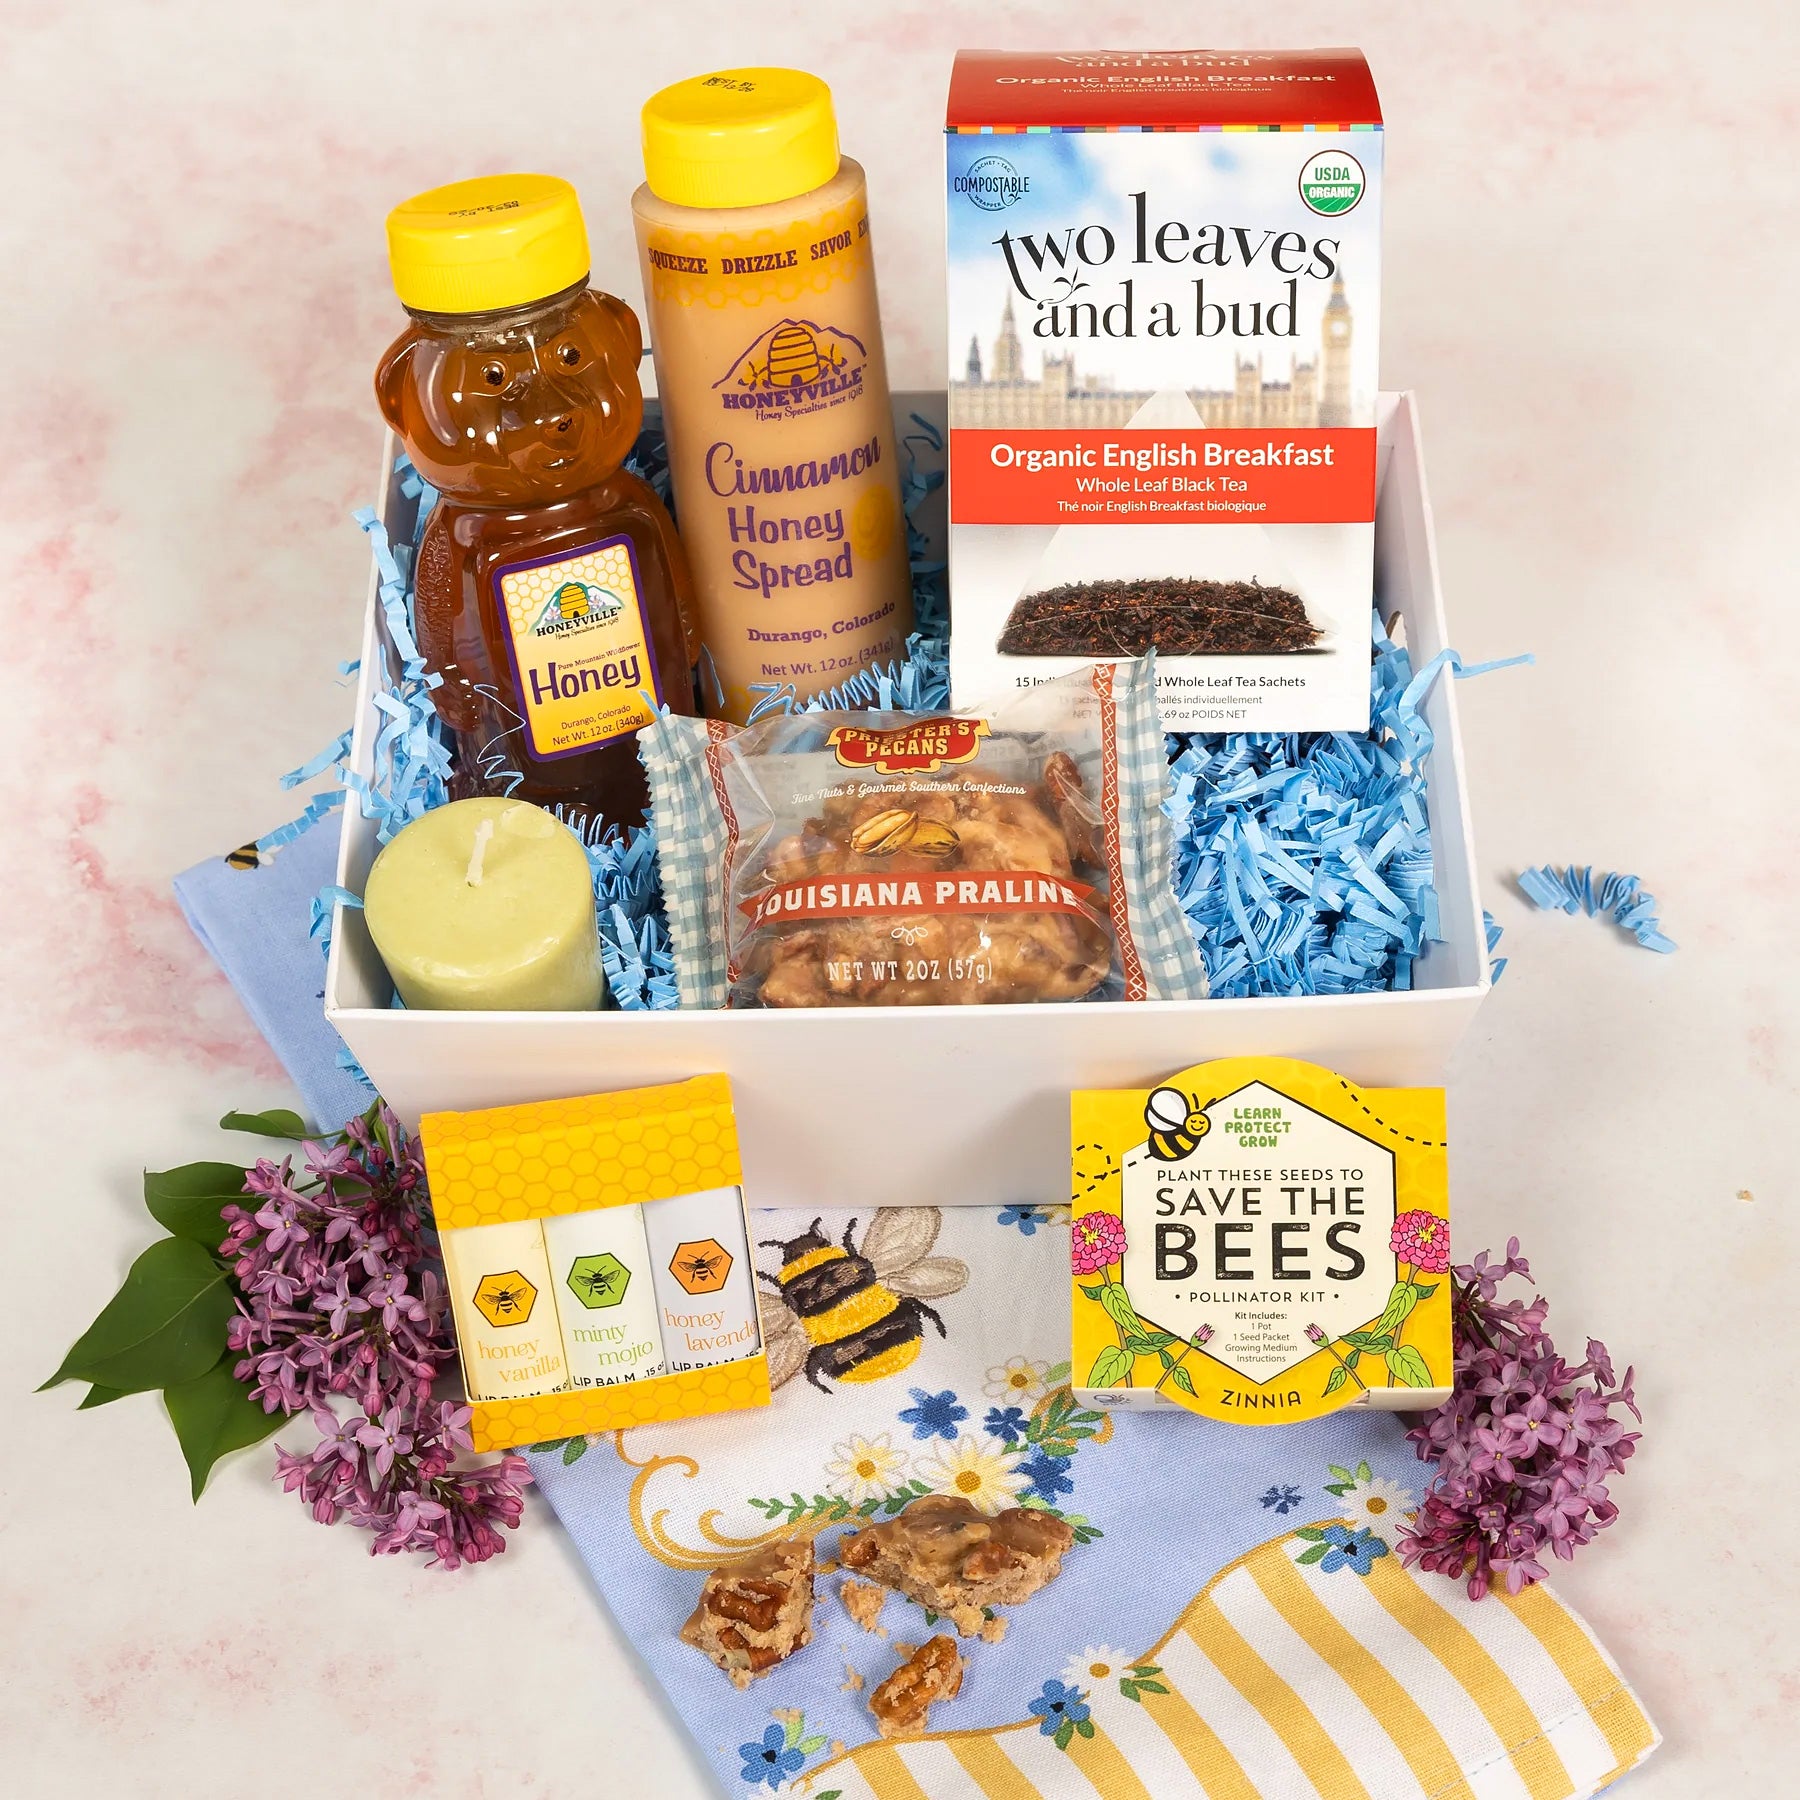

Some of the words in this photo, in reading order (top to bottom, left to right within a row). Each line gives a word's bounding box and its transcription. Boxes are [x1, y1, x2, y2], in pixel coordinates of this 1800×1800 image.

[1183, 59, 1250, 67] bud
[974, 160, 996, 173] SACHET
[1001, 162, 1012, 173] TAG
[1314, 167, 1350, 181] USDA
[954, 176, 1030, 201] COMPOSTABLE
[1309, 186, 1356, 199] ORGANIC
[974, 194, 1002, 208] WRAPPER
[648, 247, 708, 274] SQUEEZE
[721, 249, 798, 275] DRIZZLE
[810, 229, 853, 261] SAVOR
[992, 224, 1115, 302] two
[1128, 191, 1340, 280] leaves
[1033, 279, 1137, 338] and
[1147, 301, 1181, 338] a
[1191, 279, 1300, 338] bud
[722, 366, 862, 410] HONEYVILLE
[755, 408, 782, 422] Honey
[784, 402, 828, 420] Specialties
[829, 397, 846, 407] since
[848, 384, 864, 402] 1918
[705, 436, 881, 497] Cinnamon
[990, 443, 1097, 472] Organic
[1103, 442, 1197, 471] English
[1204, 441, 1335, 467] Breakfast
[1076, 477, 1131, 493] Whole
[1134, 476, 1169, 492] Leaf
[1172, 476, 1216, 492] Black
[1219, 477, 1248, 492] Tea
[1057, 501, 1079, 512] Thé
[1081, 501, 1104, 512] noir
[1106, 500, 1147, 514] English
[1149, 500, 1205, 512] Breakfast
[1207, 500, 1267, 514] biologique
[727, 504, 844, 544] Honey
[732, 541, 853, 599] Spread
[536, 607, 618, 637] HONEYVILLE
[747, 627, 828, 644] Durango,
[831, 602, 895, 635] Colorado
[558, 662, 574, 670] Pure
[574, 653, 606, 667] Mountain
[605, 641, 641, 657] Wildflower
[761, 663, 788, 676] Net
[790, 661, 817, 675] Wt.
[820, 658, 836, 671] 12
[838, 655, 858, 669] oz.
[858, 637, 894, 664] (341g)
[528, 655, 642, 705] Honey
[1015, 677, 1030, 688] 15
[1164, 676, 1205, 687] Whole
[1208, 676, 1233, 687] Leaf
[1235, 676, 1256, 687] Tea
[1259, 676, 1306, 687] Sachets
[1183, 695, 1263, 704] individuellement
[561, 714, 597, 730] Durango,
[597, 704, 631, 721] Colorado
[1191, 710, 1225, 719] POIDS
[1226, 710, 1247, 719] NET
[552, 734, 570, 747] Net
[572, 730, 590, 741] Wt.
[590, 727, 602, 738] 12
[602, 722, 616, 733] oz.
[616, 712, 644, 731] (340g)
[844, 721, 970, 745] PRIESTER'S
[865, 738, 949, 758] PECANS
[791, 792, 815, 805] Fine
[816, 787, 845, 799] Nuts
[846, 784, 856, 796] &
[858, 781, 907, 797] Gourmet
[909, 780, 961, 793] Southern
[963, 780, 1026, 796] Confections
[936, 879, 1077, 907] PRALINE
[827, 961, 863, 981] NET
[871, 960, 899, 980] WT
[948, 958, 994, 984] (57g)
[1233, 1107, 1282, 1119] LEARN
[1224, 1121, 1292, 1134] PROTECT
[1238, 1135, 1278, 1148] GROW
[1157, 1169, 1213, 1182] PLANT
[1220, 1169, 1273, 1181] THESE
[1280, 1169, 1334, 1181] SEEDS
[1342, 1169, 1364, 1181] TO
[1155, 1187, 1262, 1216] SAVE
[1281, 1187, 1365, 1216] THE
[1155, 1221, 1366, 1281] BEES
[1189, 1292, 1293, 1303] POLLINATOR
[1300, 1291, 1326, 1303] KIT
[664, 1307, 725, 1330] honey
[1234, 1312, 1247, 1320] Kit
[1248, 1312, 1288, 1320] Includes:
[1257, 1322, 1272, 1330] Pot
[573, 1324, 628, 1345] minty
[1239, 1333, 1260, 1341] Seed
[1262, 1333, 1290, 1341] Packet
[478, 1338, 540, 1360] honey
[1225, 1343, 1261, 1353] Growing
[1262, 1343, 1298, 1352] Medium
[1236, 1354, 1286, 1363] Instructions
[499, 1355, 561, 1384] vanilla
[573, 1375, 591, 1387] LIP
[596, 1372, 636, 1387] BALM
[1220, 1388, 1302, 1409] ZINNIA
